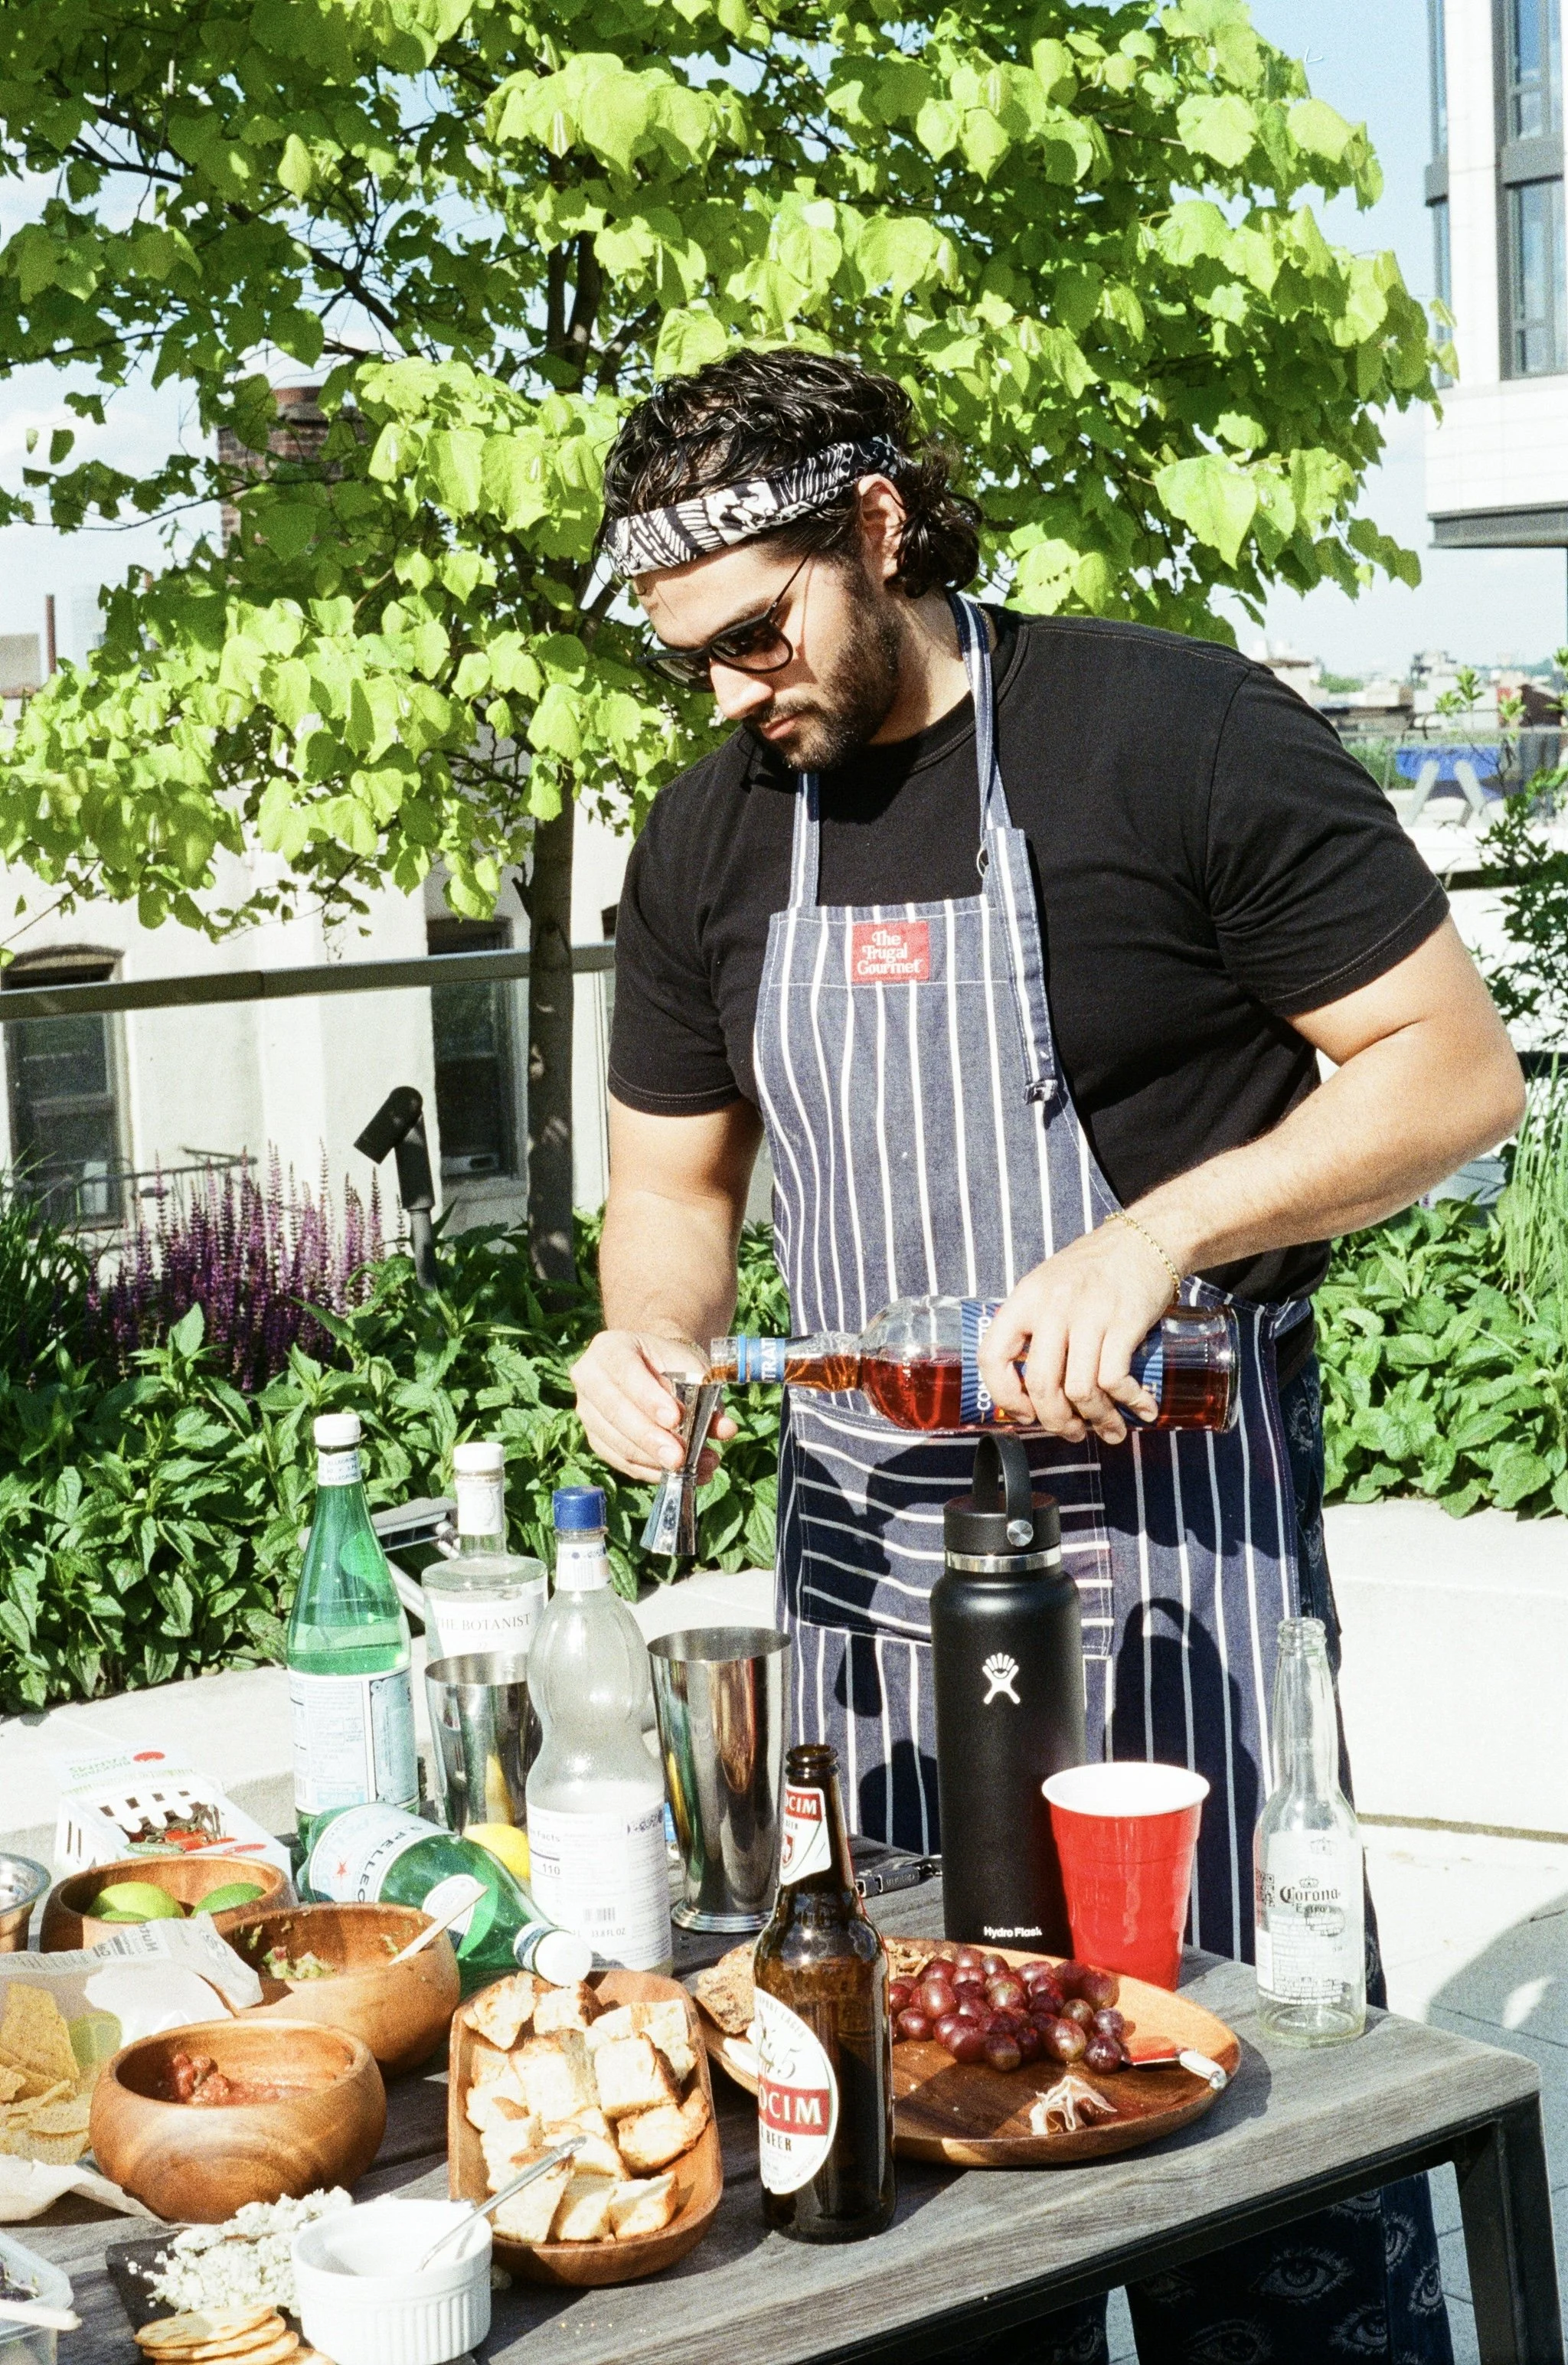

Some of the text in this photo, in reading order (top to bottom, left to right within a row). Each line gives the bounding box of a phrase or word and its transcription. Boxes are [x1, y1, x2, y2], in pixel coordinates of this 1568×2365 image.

[871, 929, 901, 946] The
[862, 942, 907, 963] Frugal
[857, 959, 923, 975] Gourmet
[436, 1613, 531, 1631] THE BOTANIST
[537, 1829, 560, 1843] Facts
[542, 1863, 560, 1876] 110
[1279, 1886, 1339, 1904] Corona
[616, 1927, 626, 1936] OZ
[984, 1926, 1042, 1939] Hydro Flask
